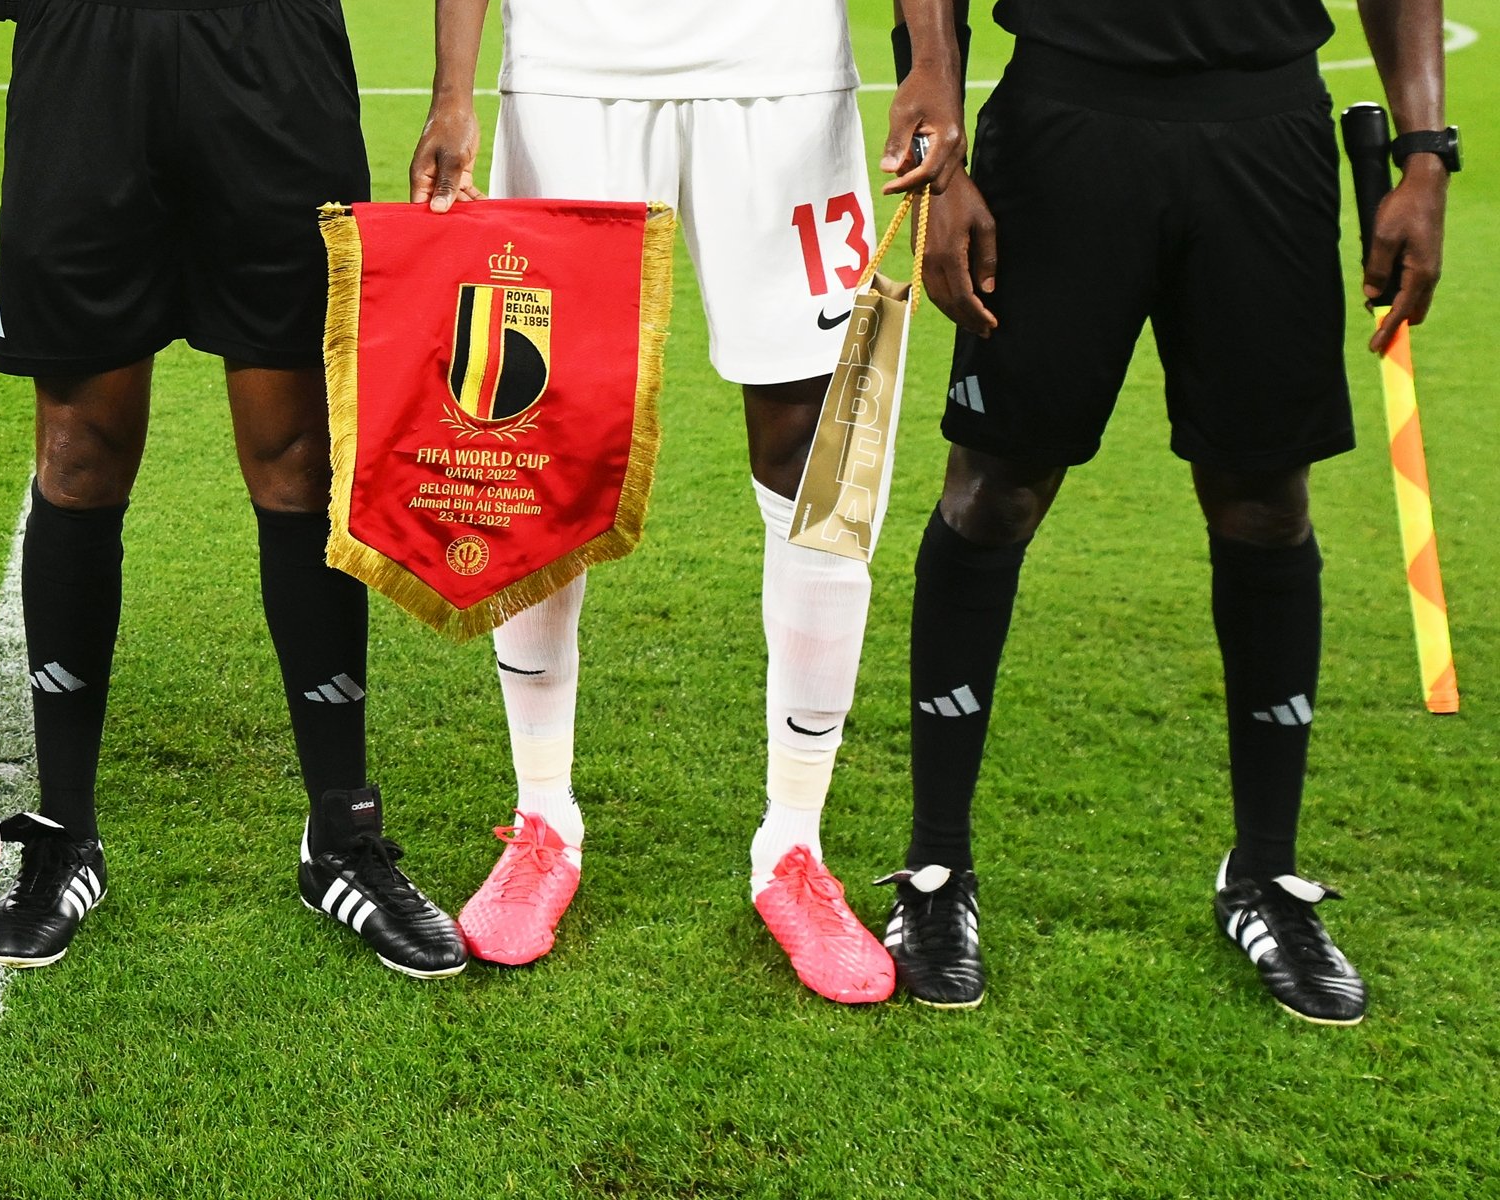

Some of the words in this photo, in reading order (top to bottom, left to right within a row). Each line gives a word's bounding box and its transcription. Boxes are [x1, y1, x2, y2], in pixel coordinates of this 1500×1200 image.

[792, 191, 870, 297] 13
[506, 291, 539, 303] ROYAL
[505, 302, 550, 316] BELGIAN
[821, 304, 884, 552] RBFA
[417, 448, 451, 465] FIFA
[455, 449, 513, 467] WORLD
[515, 453, 550, 470] CUP
[445, 466, 483, 481] QATAR
[485, 469, 517, 481] 2022
[419, 483, 475, 497] BELGIUM
[487, 486, 535, 501] CANADA
[408, 497, 451, 509] Ahmad
[453, 498, 473, 511] Bin
[475, 500, 491, 512] Ali
[494, 502, 542, 515] Stadium
[437, 511, 511, 528] 23.11.2022
